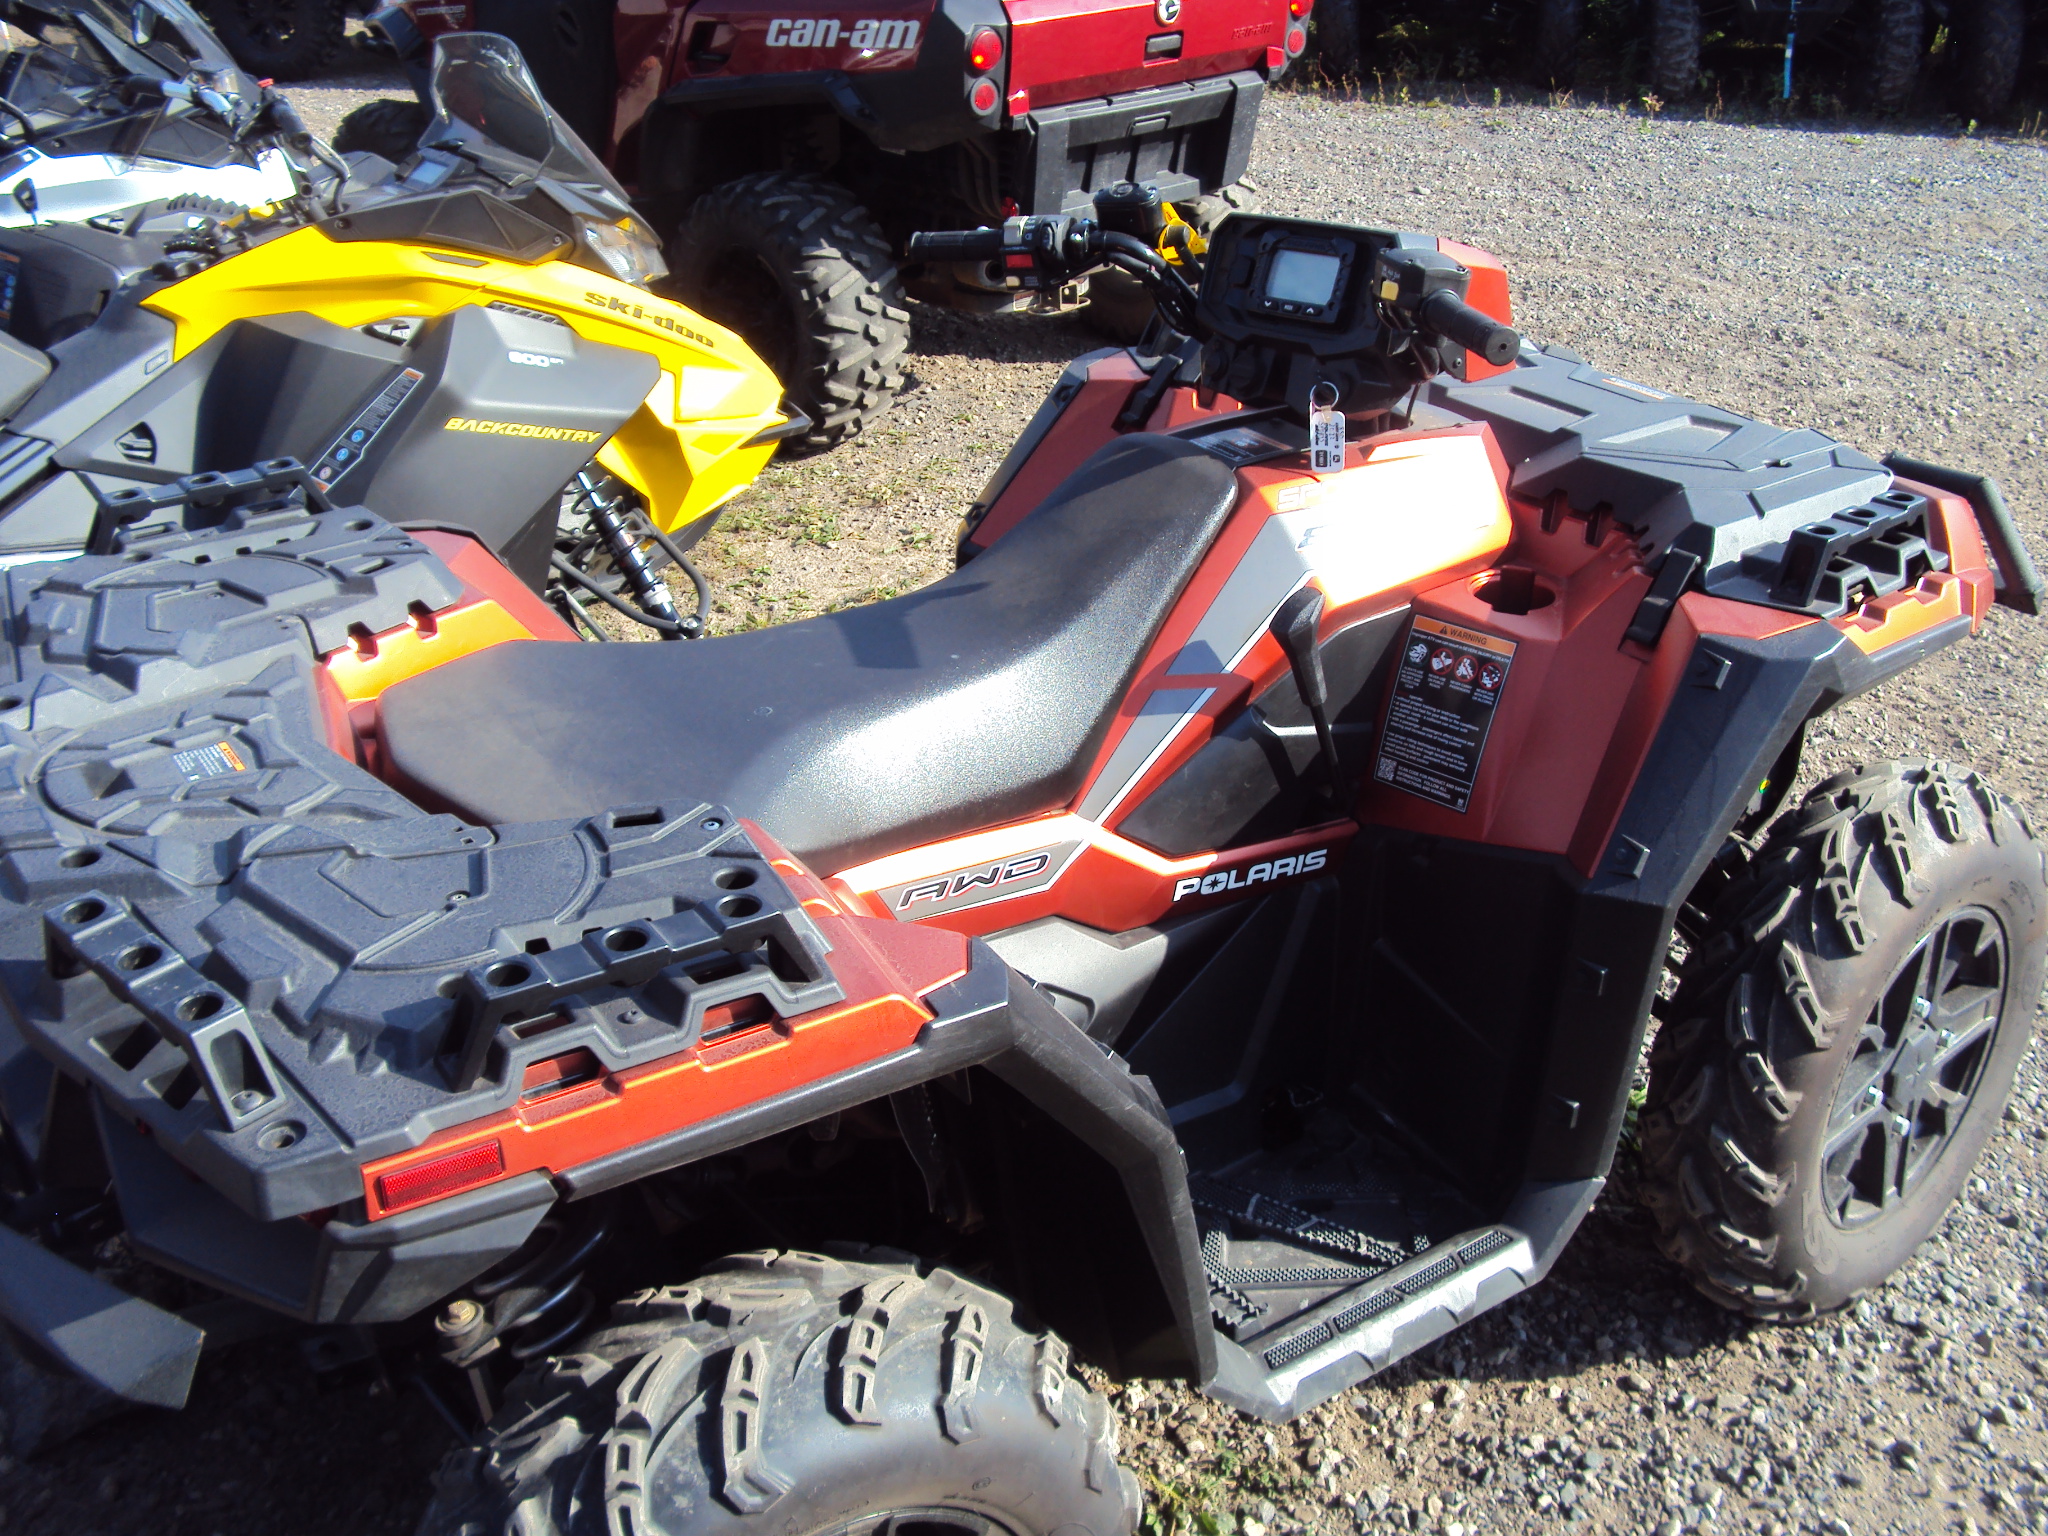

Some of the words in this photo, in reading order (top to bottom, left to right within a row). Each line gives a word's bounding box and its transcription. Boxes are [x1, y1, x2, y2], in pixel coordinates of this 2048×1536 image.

[765, 18, 921, 49] can-am
[584, 292, 714, 348] ski-doo
[444, 416, 602, 443] BACKCOUNTRY
[1450, 629, 1488, 645] WARNING
[1395, 775, 1421, 788] INSTRUCTIONS
[1423, 780, 1439, 788] FOLLOW
[1427, 776, 1445, 785] PRODUCT
[1454, 786, 1469, 794] SAFETY
[896, 851, 1051, 911] AWD
[1172, 848, 1328, 902] POLARIS
